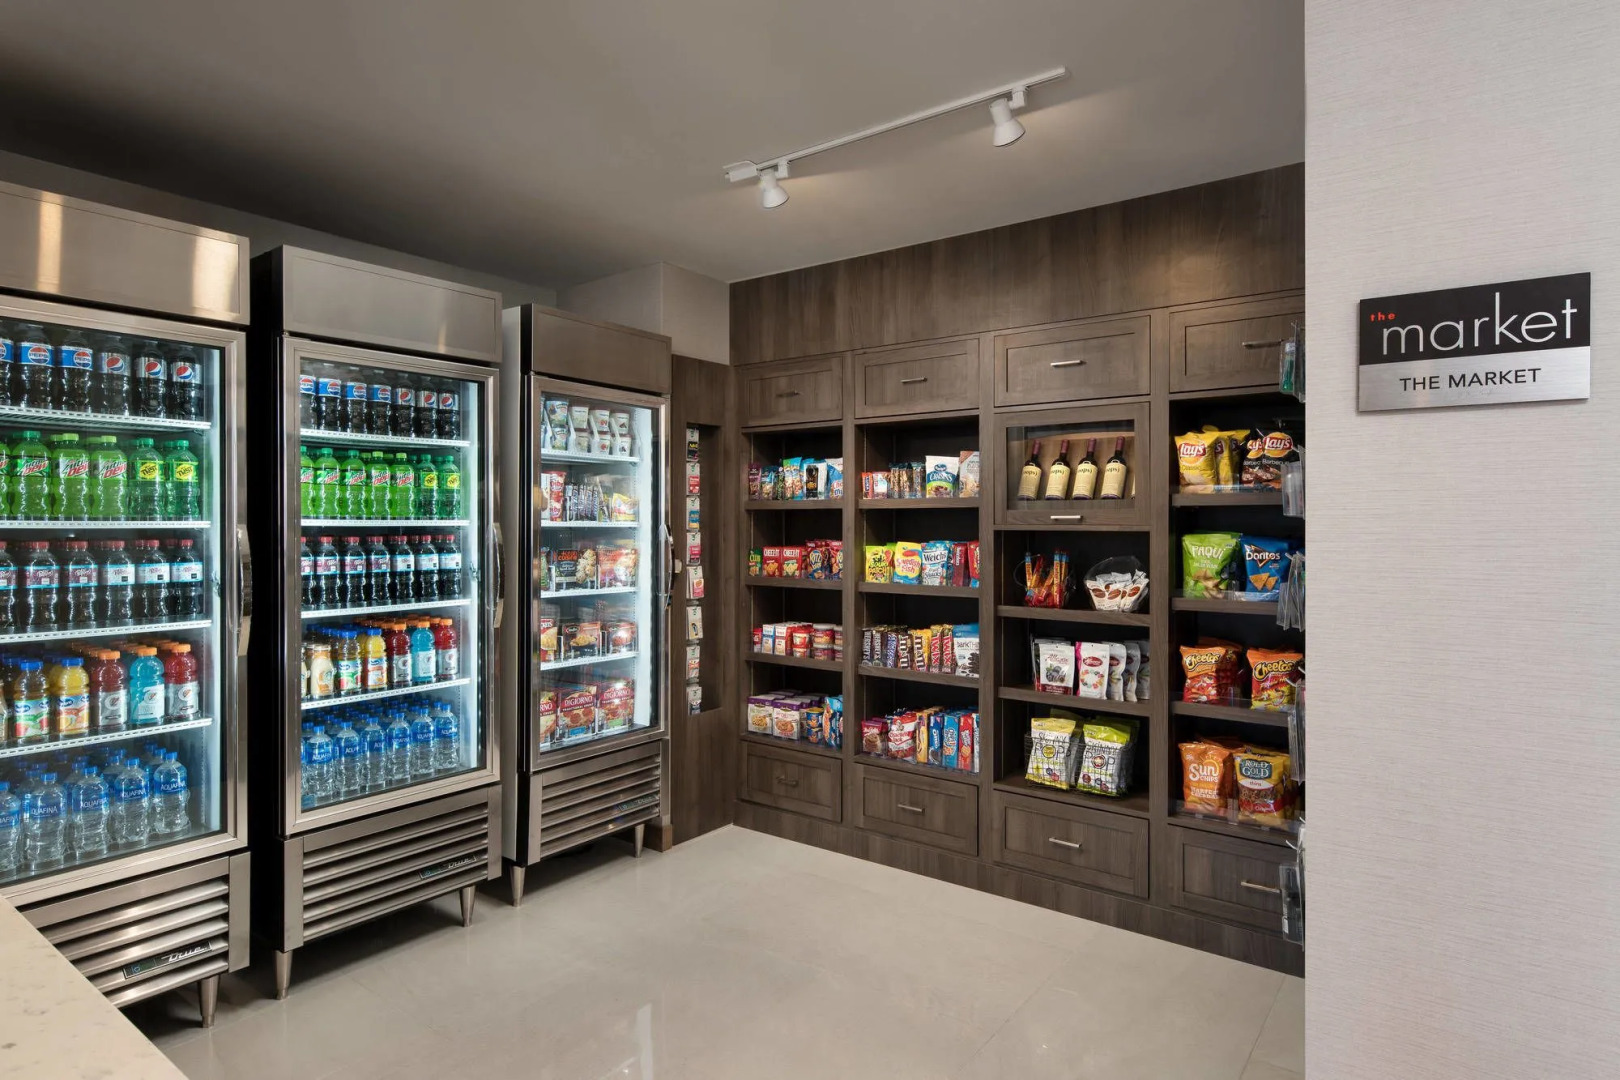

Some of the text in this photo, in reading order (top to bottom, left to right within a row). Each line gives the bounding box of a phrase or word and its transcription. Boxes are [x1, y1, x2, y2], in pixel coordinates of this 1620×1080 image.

[1370, 312, 1395, 322] the
[1383, 292, 1577, 355] market
[1399, 368, 1541, 391] THE MARKET
[1246, 551, 1280, 561] Doritos
[1186, 653, 1221, 670] Cheetos
[1255, 660, 1294, 680] Cheetos
[1188, 763, 1220, 781] Sun
[1200, 775, 1219, 783] CHIPS
[1242, 766, 1269, 778] GOLD
